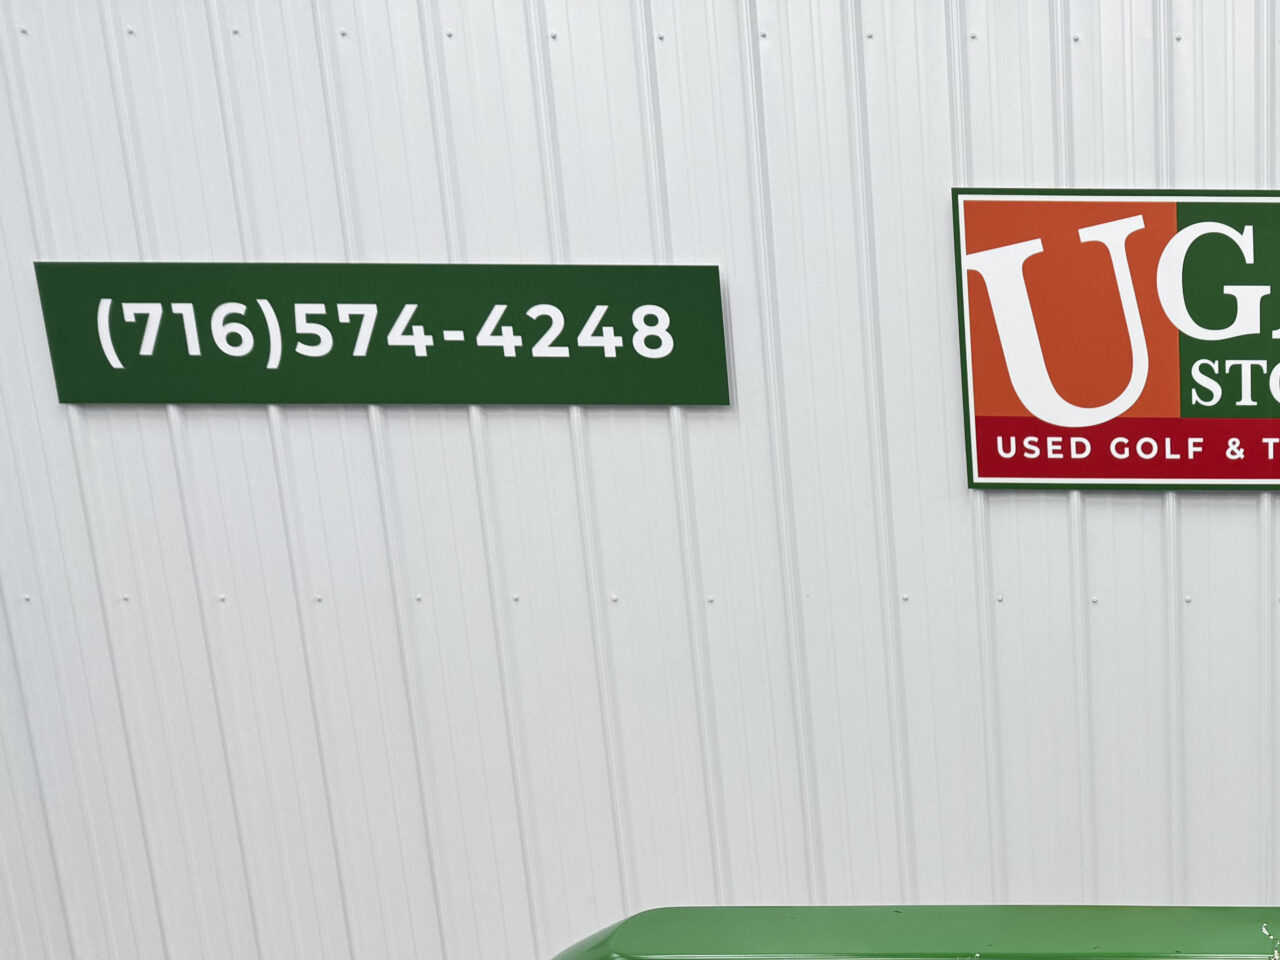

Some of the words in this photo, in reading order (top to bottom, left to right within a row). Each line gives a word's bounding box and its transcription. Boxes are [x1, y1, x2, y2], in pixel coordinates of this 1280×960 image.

[96, 298, 675, 370] (716)574-4248
[995, 434, 1093, 461] USED
[1108, 435, 1205, 461] GOLF
[1225, 437, 1245, 460] &
